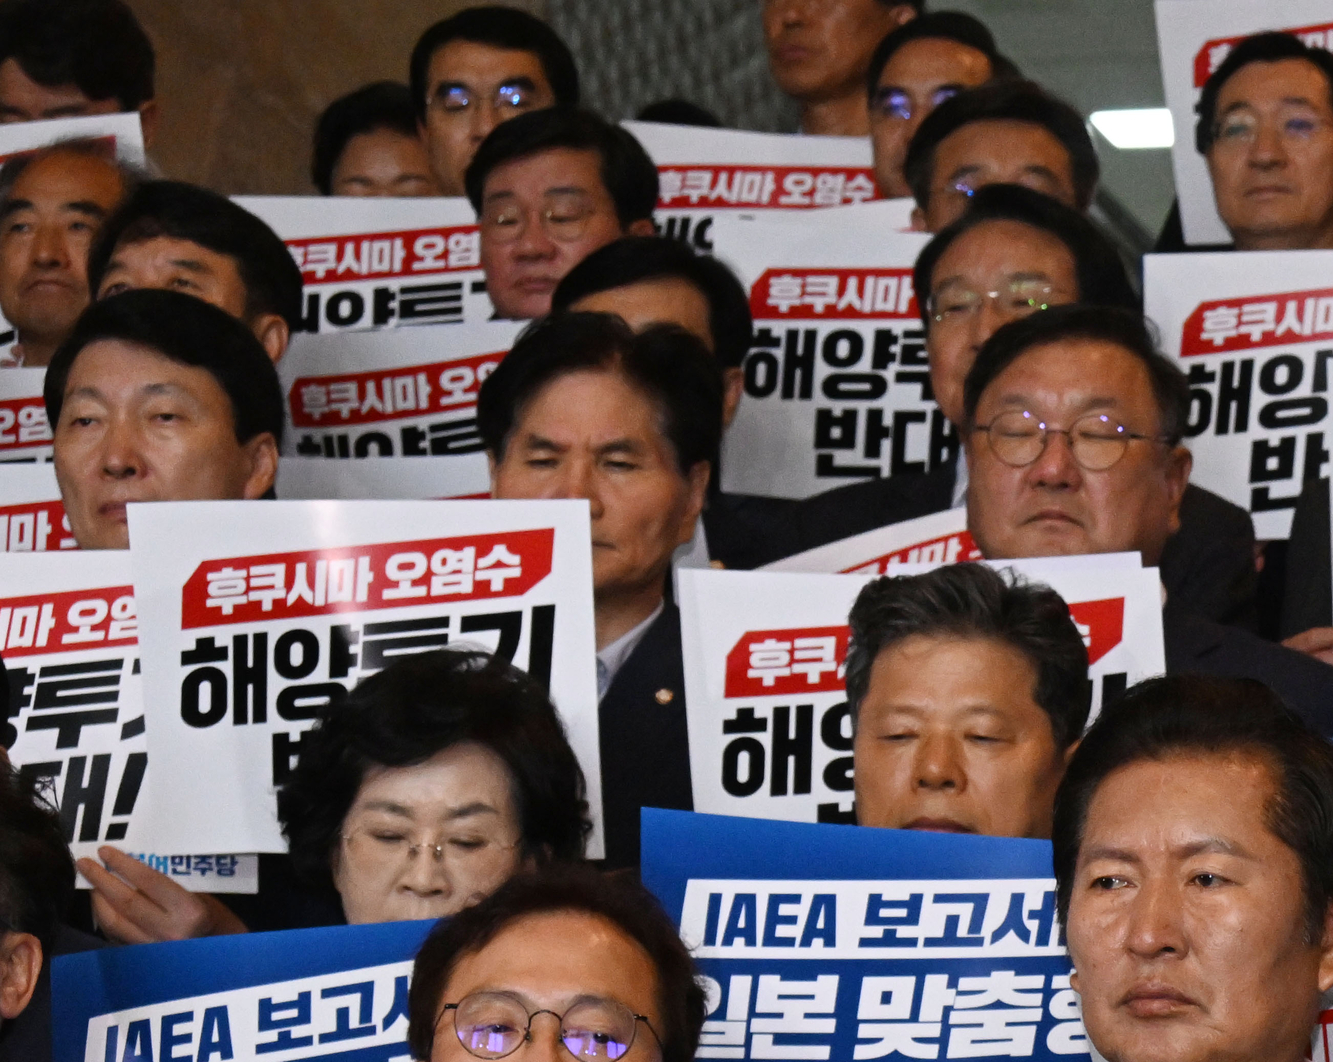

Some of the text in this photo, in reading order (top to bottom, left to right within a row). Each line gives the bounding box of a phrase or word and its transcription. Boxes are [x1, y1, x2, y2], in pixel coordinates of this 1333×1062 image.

[288, 233, 482, 278] 쿠시마 오염
[767, 275, 914, 314] 후쿠시마
[744, 327, 931, 402] 해양
[301, 371, 432, 421] 후쿠시마
[205, 542, 522, 615] 후쿠시마 오염수
[703, 892, 837, 948] IAEA
[697, 972, 839, 1062] 일본
